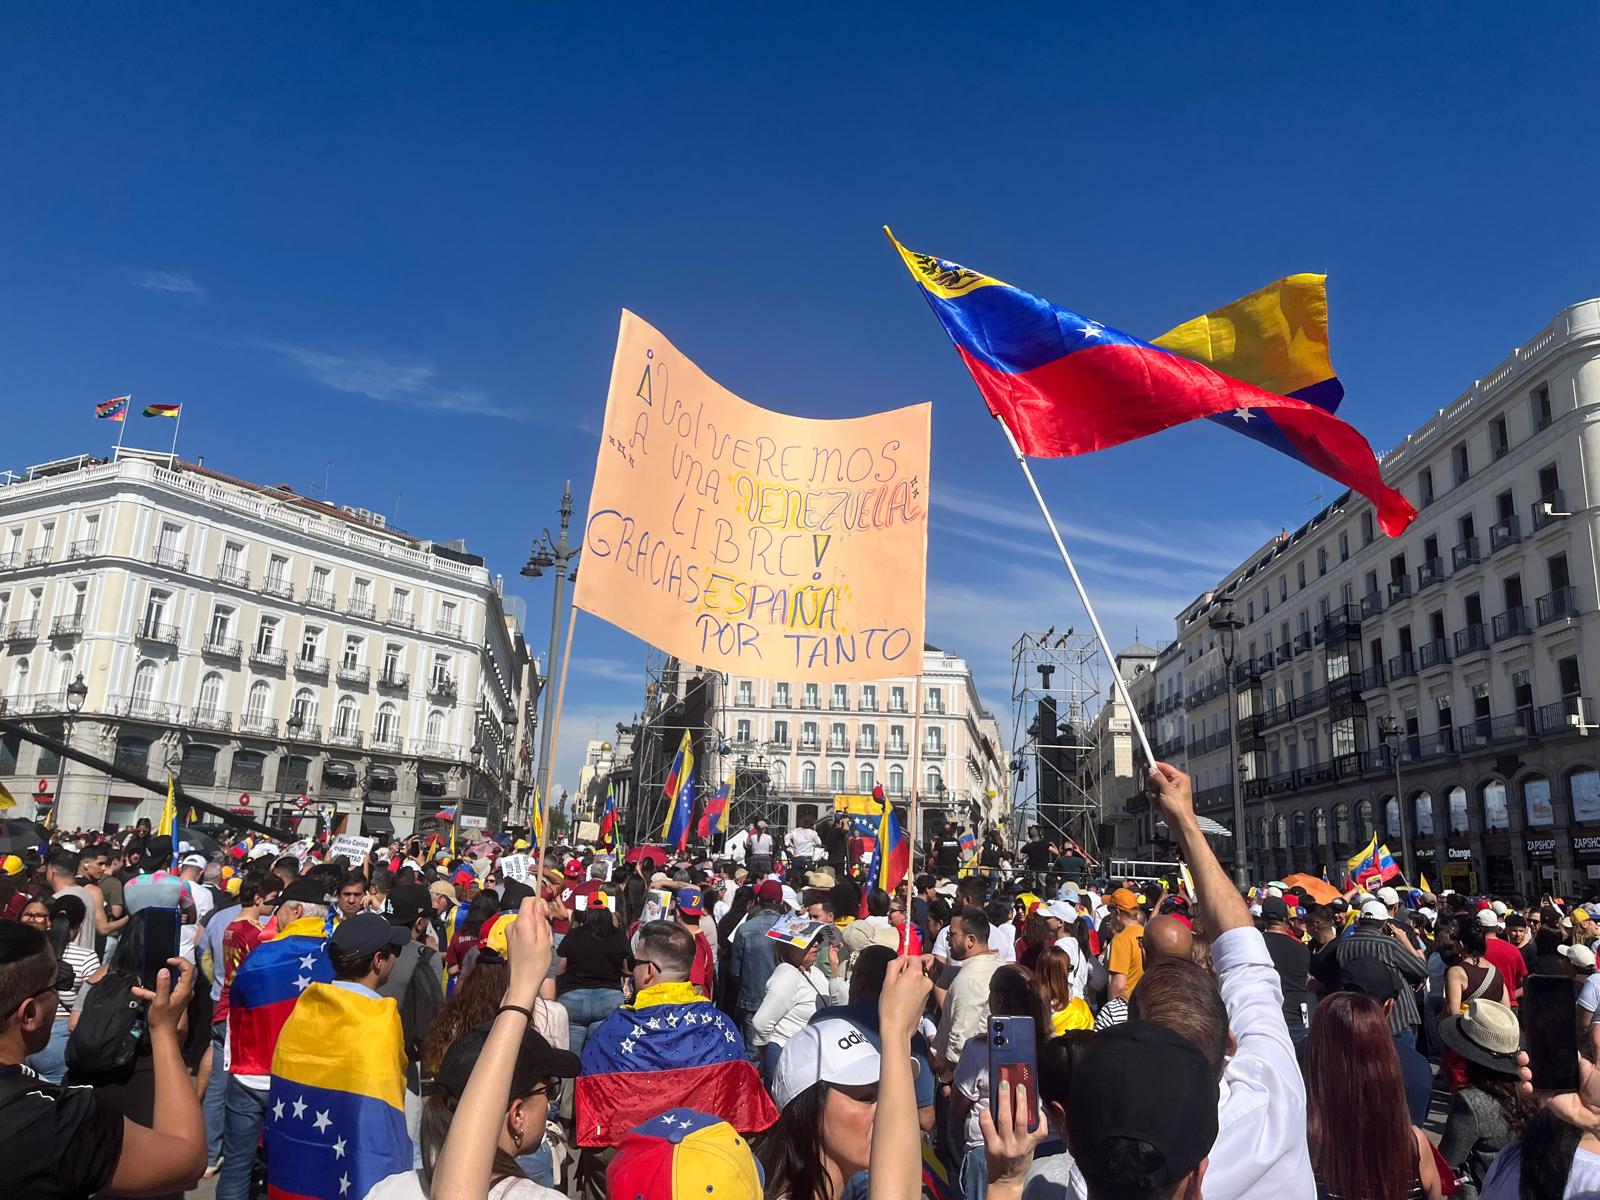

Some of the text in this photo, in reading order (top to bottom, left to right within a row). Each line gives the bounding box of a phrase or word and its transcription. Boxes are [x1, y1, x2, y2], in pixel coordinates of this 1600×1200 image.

[629, 412, 648, 455] A
[587, 510, 838, 630] GRACIAS ESPAÑA
[696, 613, 912, 668] POR TANTO
[1448, 848, 1471, 860] Change
[1527, 839, 1556, 851] ZAPSHOP
[1573, 837, 1600, 849] ZAPSHO
